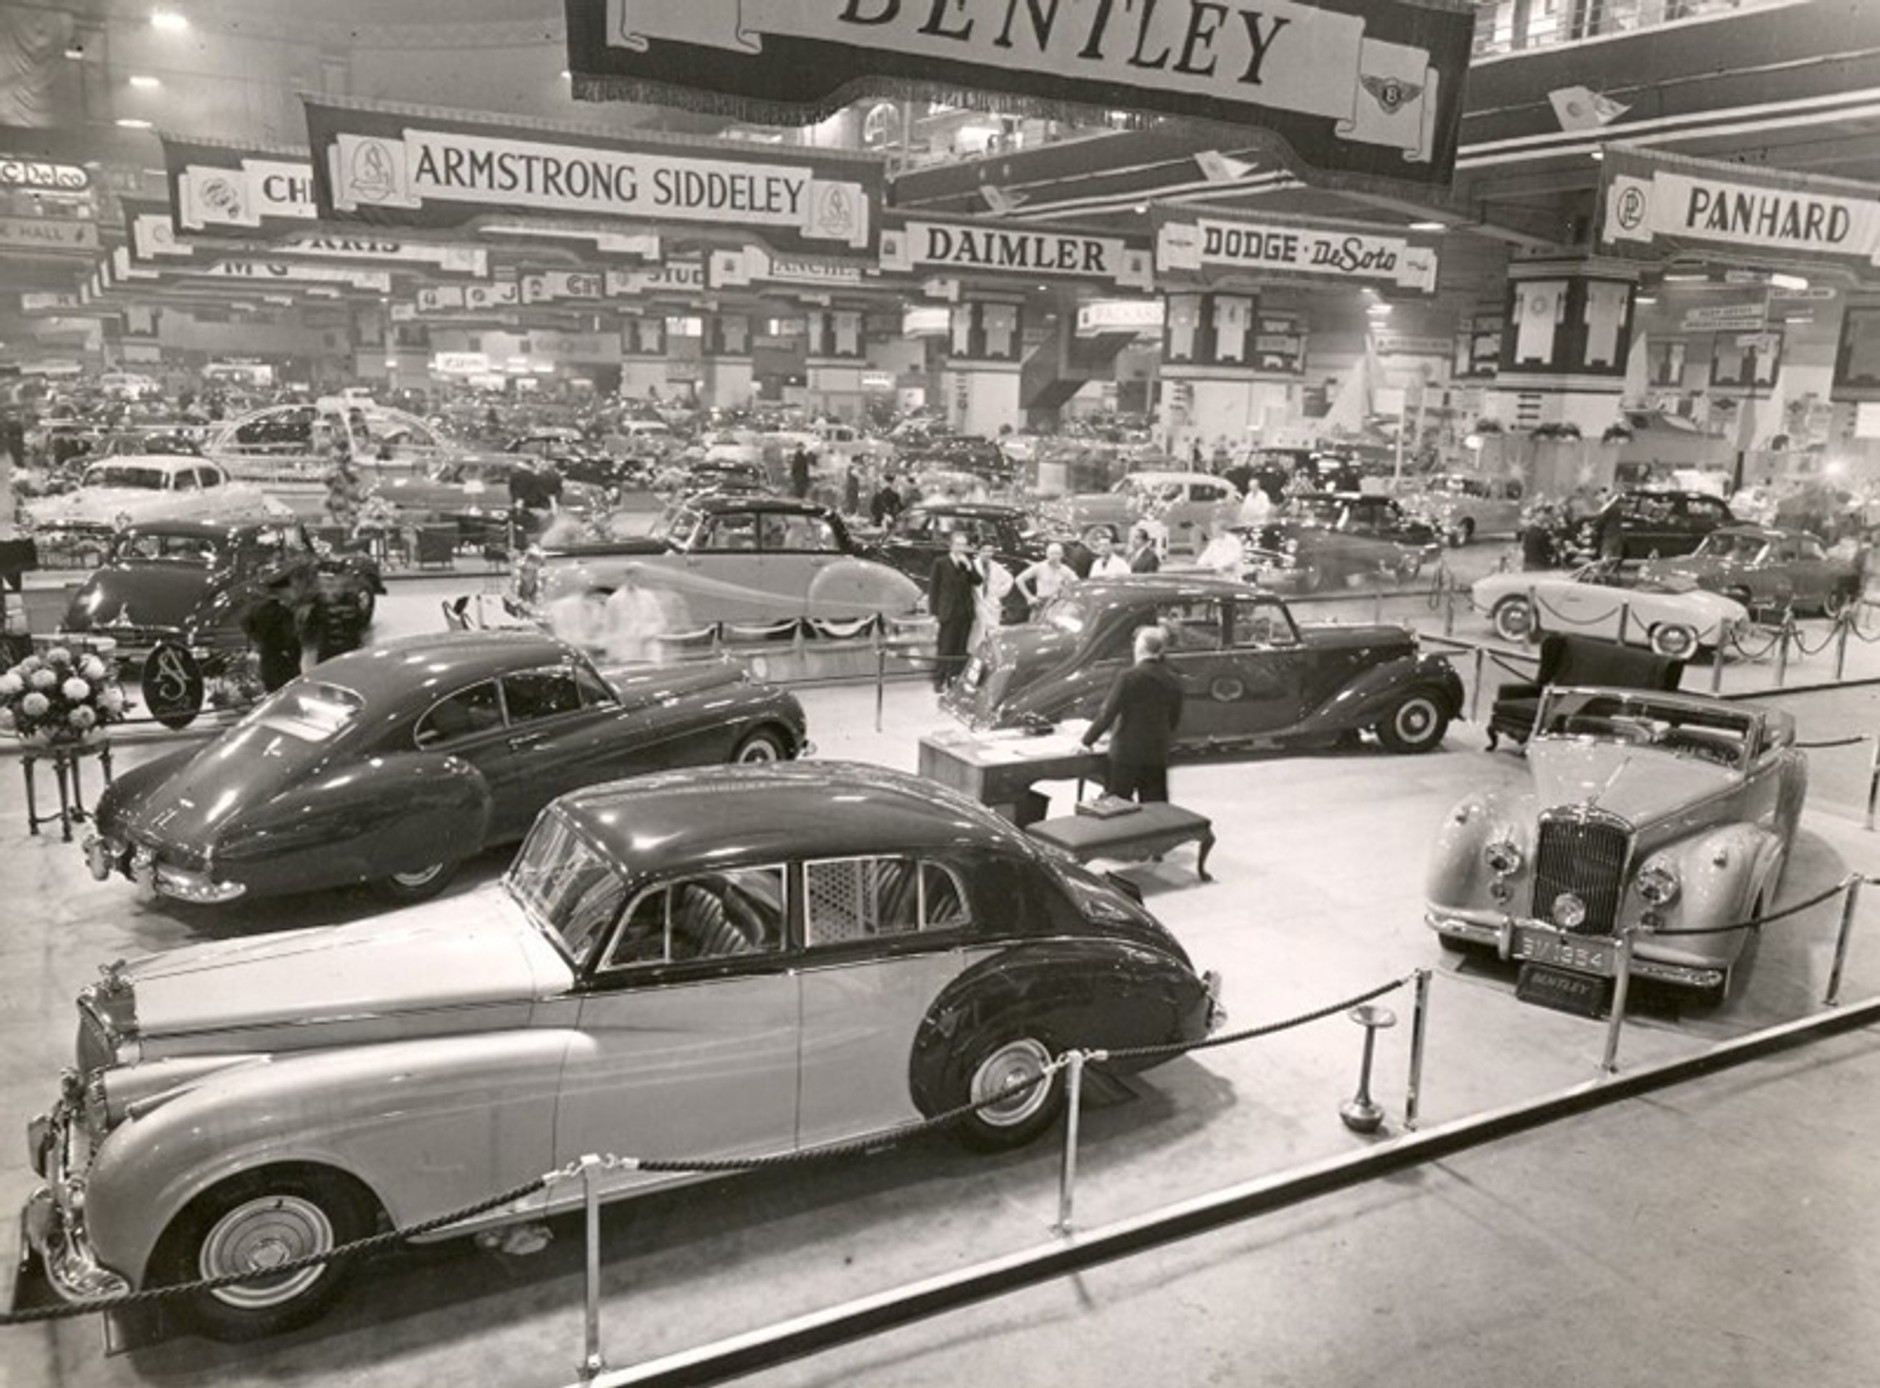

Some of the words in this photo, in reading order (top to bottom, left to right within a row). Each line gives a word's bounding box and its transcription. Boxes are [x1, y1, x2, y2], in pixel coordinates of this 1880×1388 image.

[414, 145, 638, 201] ARMSTRONG
[653, 167, 806, 215] SIDDELEY
[1686, 186, 1850, 243] PANHARD
[928, 226, 1107, 273] DAIMLER
[1203, 227, 1298, 263] DODGE
[1311, 237, 1397, 273] DeSoto
